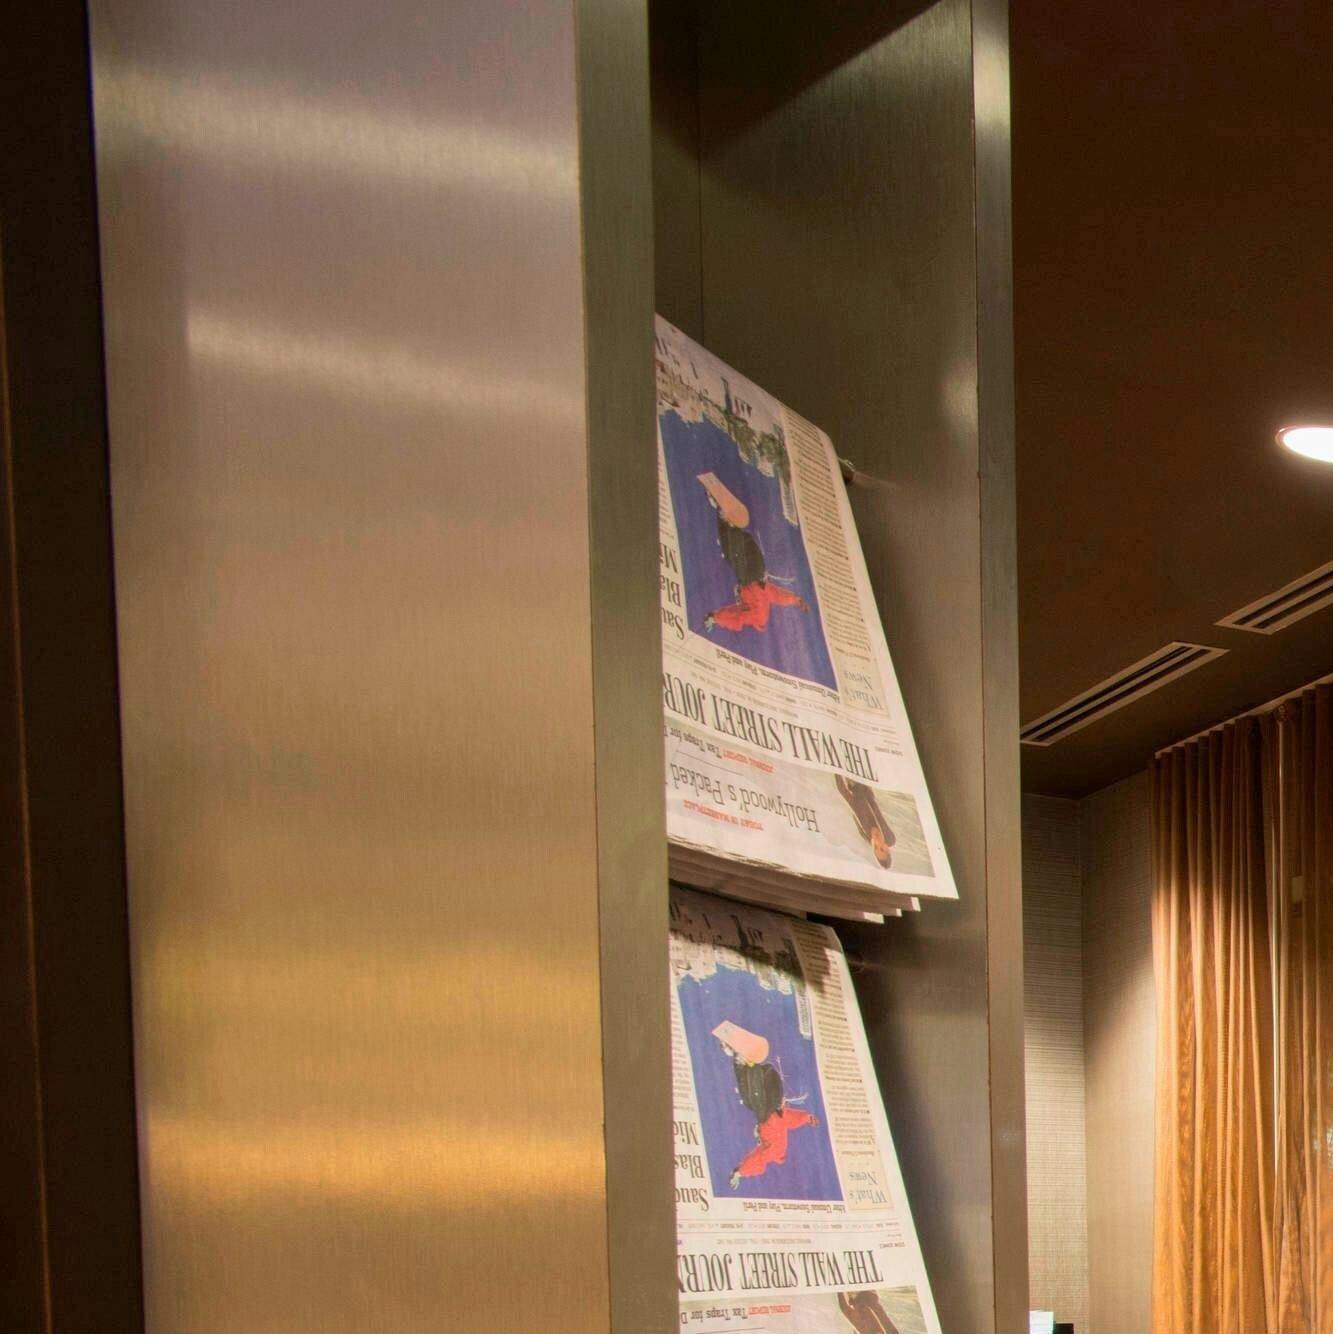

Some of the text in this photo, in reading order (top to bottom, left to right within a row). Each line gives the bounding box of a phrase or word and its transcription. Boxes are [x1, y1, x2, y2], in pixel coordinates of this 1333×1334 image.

[662, 673, 707, 726] JOUR
[711, 693, 783, 753] STREET
[782, 721, 843, 769] WALL
[839, 738, 879, 782] THE
[670, 763, 820, 833] Hollywood's Packed
[677, 1249, 883, 1294] THE WALL STREET JOUR
[690, 1309, 703, 1323] for
[706, 1307, 731, 1321] Traps
[732, 1307, 748, 1320] Tax
